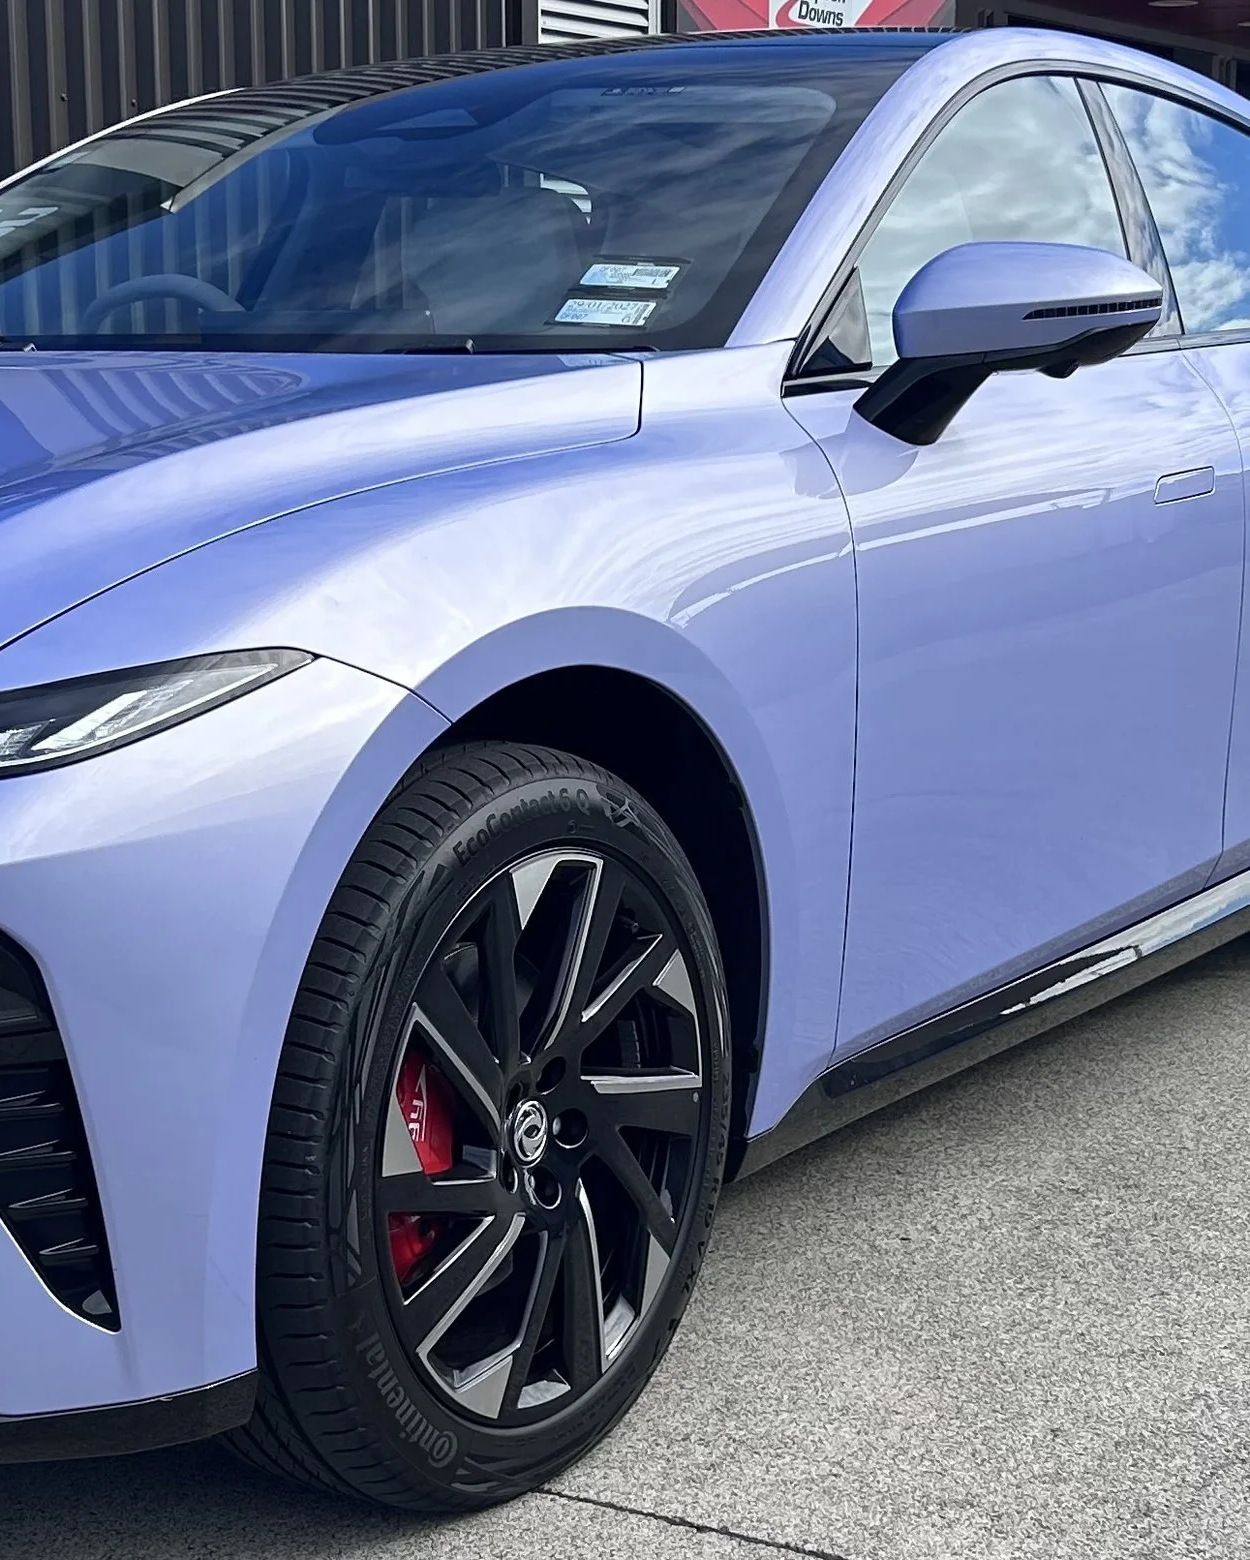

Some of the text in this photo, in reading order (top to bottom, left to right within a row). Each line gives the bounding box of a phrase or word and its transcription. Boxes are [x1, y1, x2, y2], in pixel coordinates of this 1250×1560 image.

[797, 0, 844, 27] Downs
[452, 790, 559, 867] EcoContact
[558, 787, 571, 812] 6
[575, 788, 591, 818] Q
[356, 1331, 458, 1469] Continental
